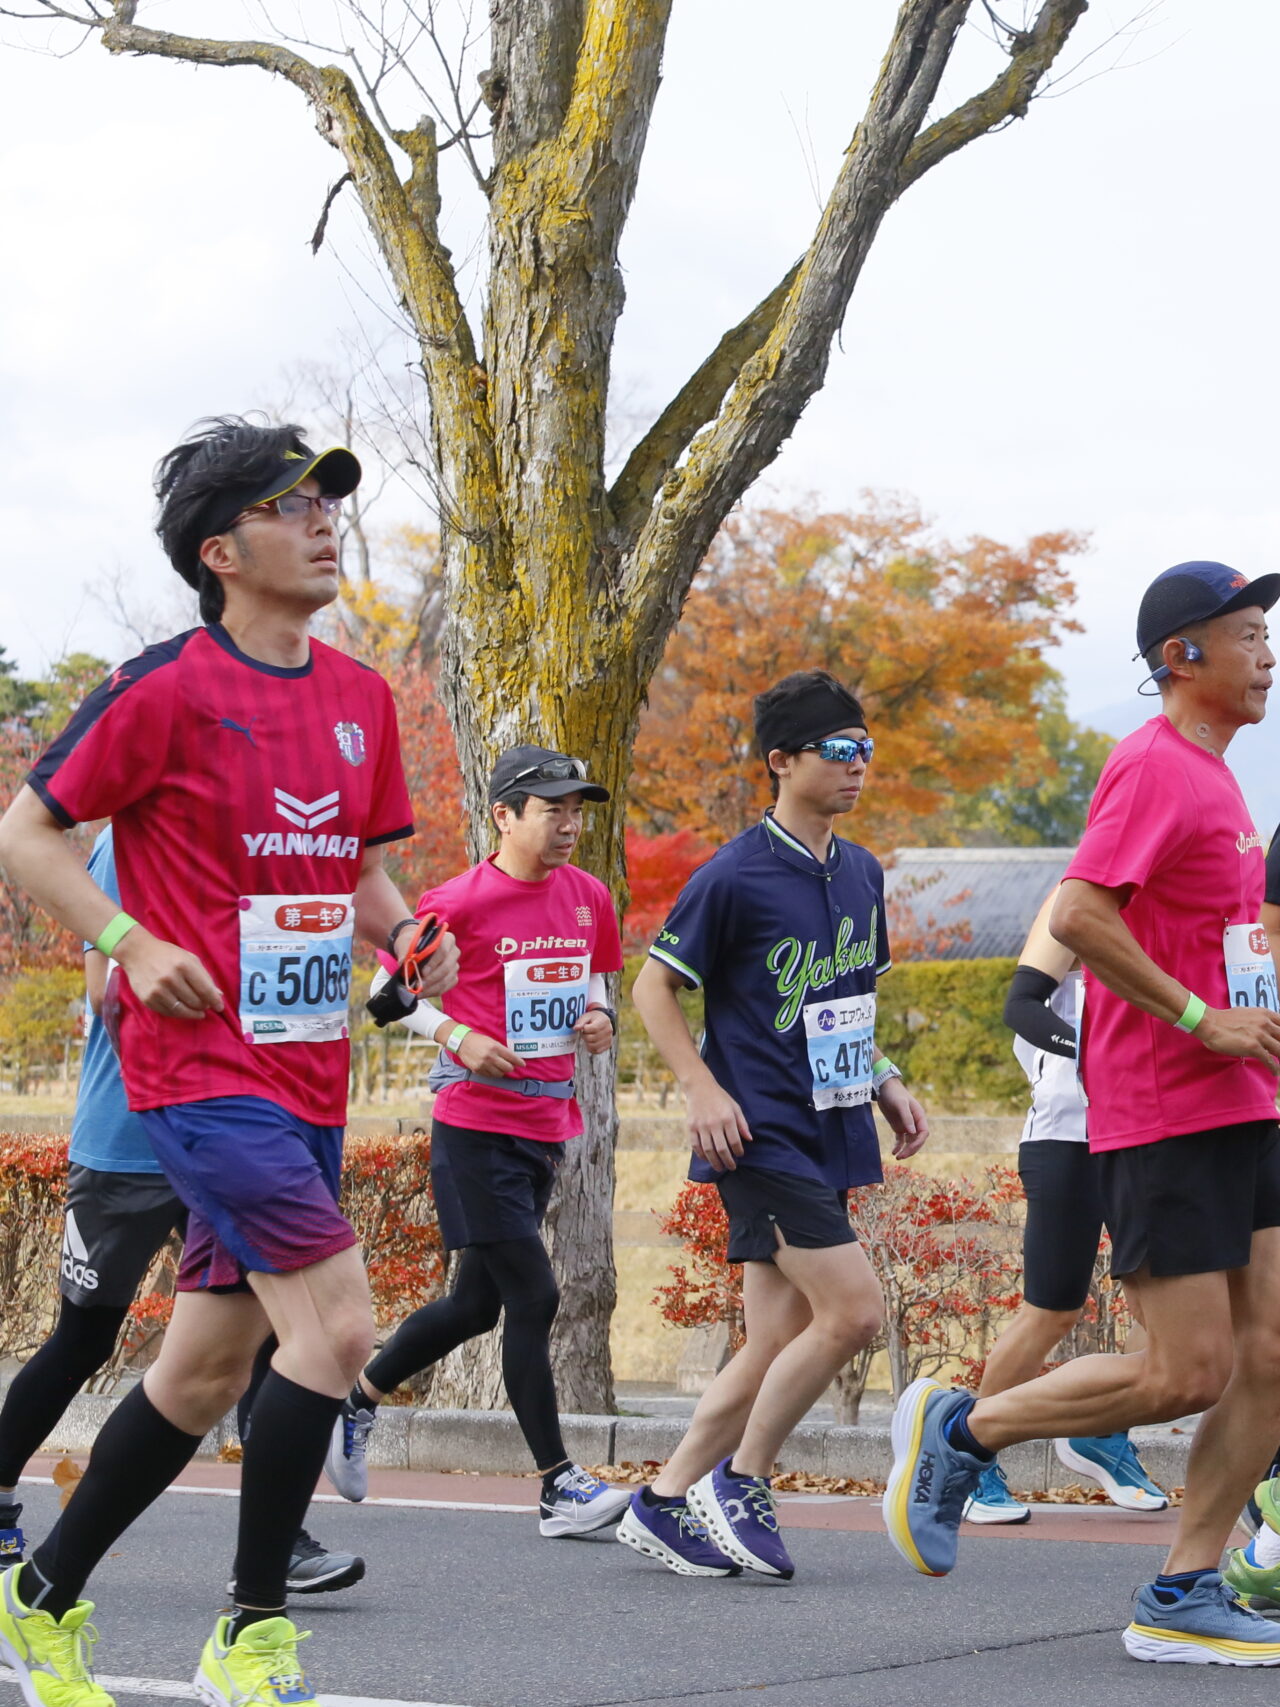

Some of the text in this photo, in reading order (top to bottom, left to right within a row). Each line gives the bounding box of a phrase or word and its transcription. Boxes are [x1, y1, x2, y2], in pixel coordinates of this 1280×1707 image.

[241, 832, 360, 860] YANMAR
[521, 936, 587, 956] phiten
[249, 951, 351, 1007] C 5066
[533, 964, 581, 982] 第一生命
[511, 993, 586, 1033] C 5080
[815, 1058, 831, 1083] C
[914, 1450, 937, 1504] HOKA
